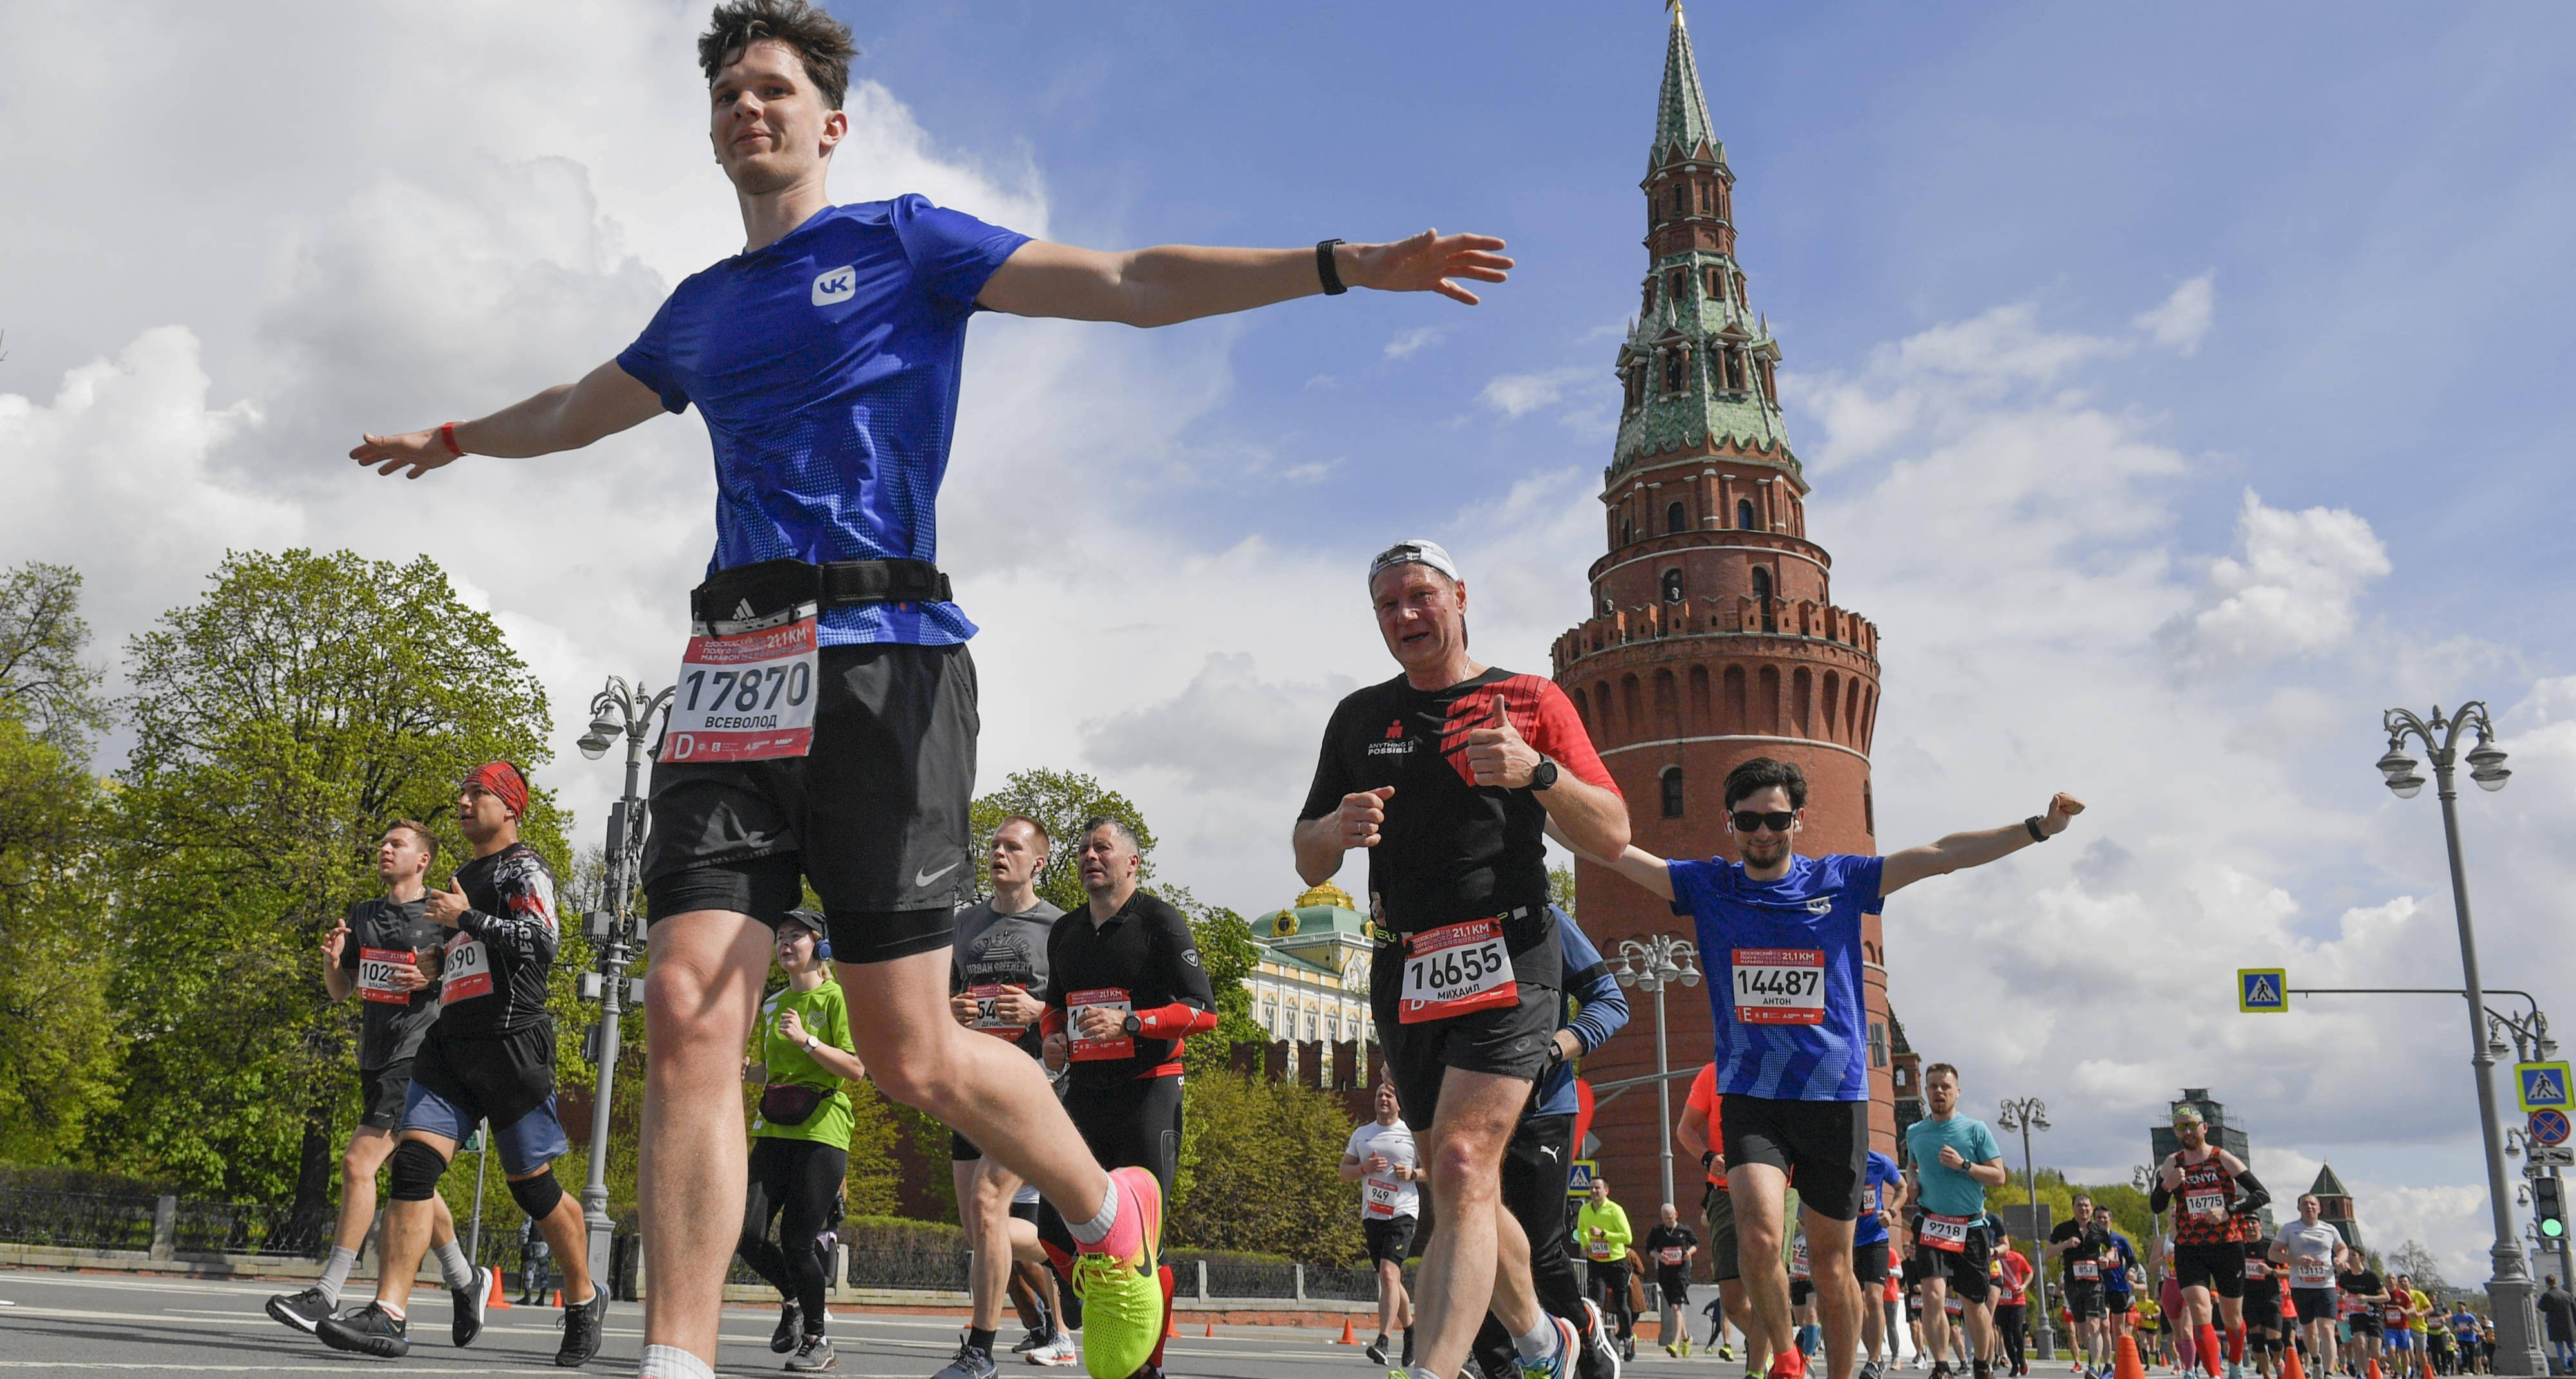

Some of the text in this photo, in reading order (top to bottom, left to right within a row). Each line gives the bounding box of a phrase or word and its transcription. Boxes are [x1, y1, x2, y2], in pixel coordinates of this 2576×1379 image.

[820, 276, 848, 294] VK
[686, 662, 810, 712] 17870
[705, 715, 777, 729] ВСЕВОЛОД
[674, 734, 694, 759] D
[1368, 746, 1413, 756] POSSIBLE
[1452, 926, 1470, 938] 21,1
[1782, 952, 1797, 961] 21,1
[967, 961, 1031, 974] URBAN GREENERY
[1411, 943, 1502, 990] 16655
[1738, 970, 1818, 995] 14487
[362, 988, 367, 999] E
[1437, 983, 1480, 1000] МИХАИЛ
[1743, 1008, 1752, 1021] E
[1073, 1041, 1078, 1053] E
[1372, 1188, 1389, 1201] 949
[2189, 1196, 2222, 1208] 16775
[1929, 1222, 1960, 1236] 9718
